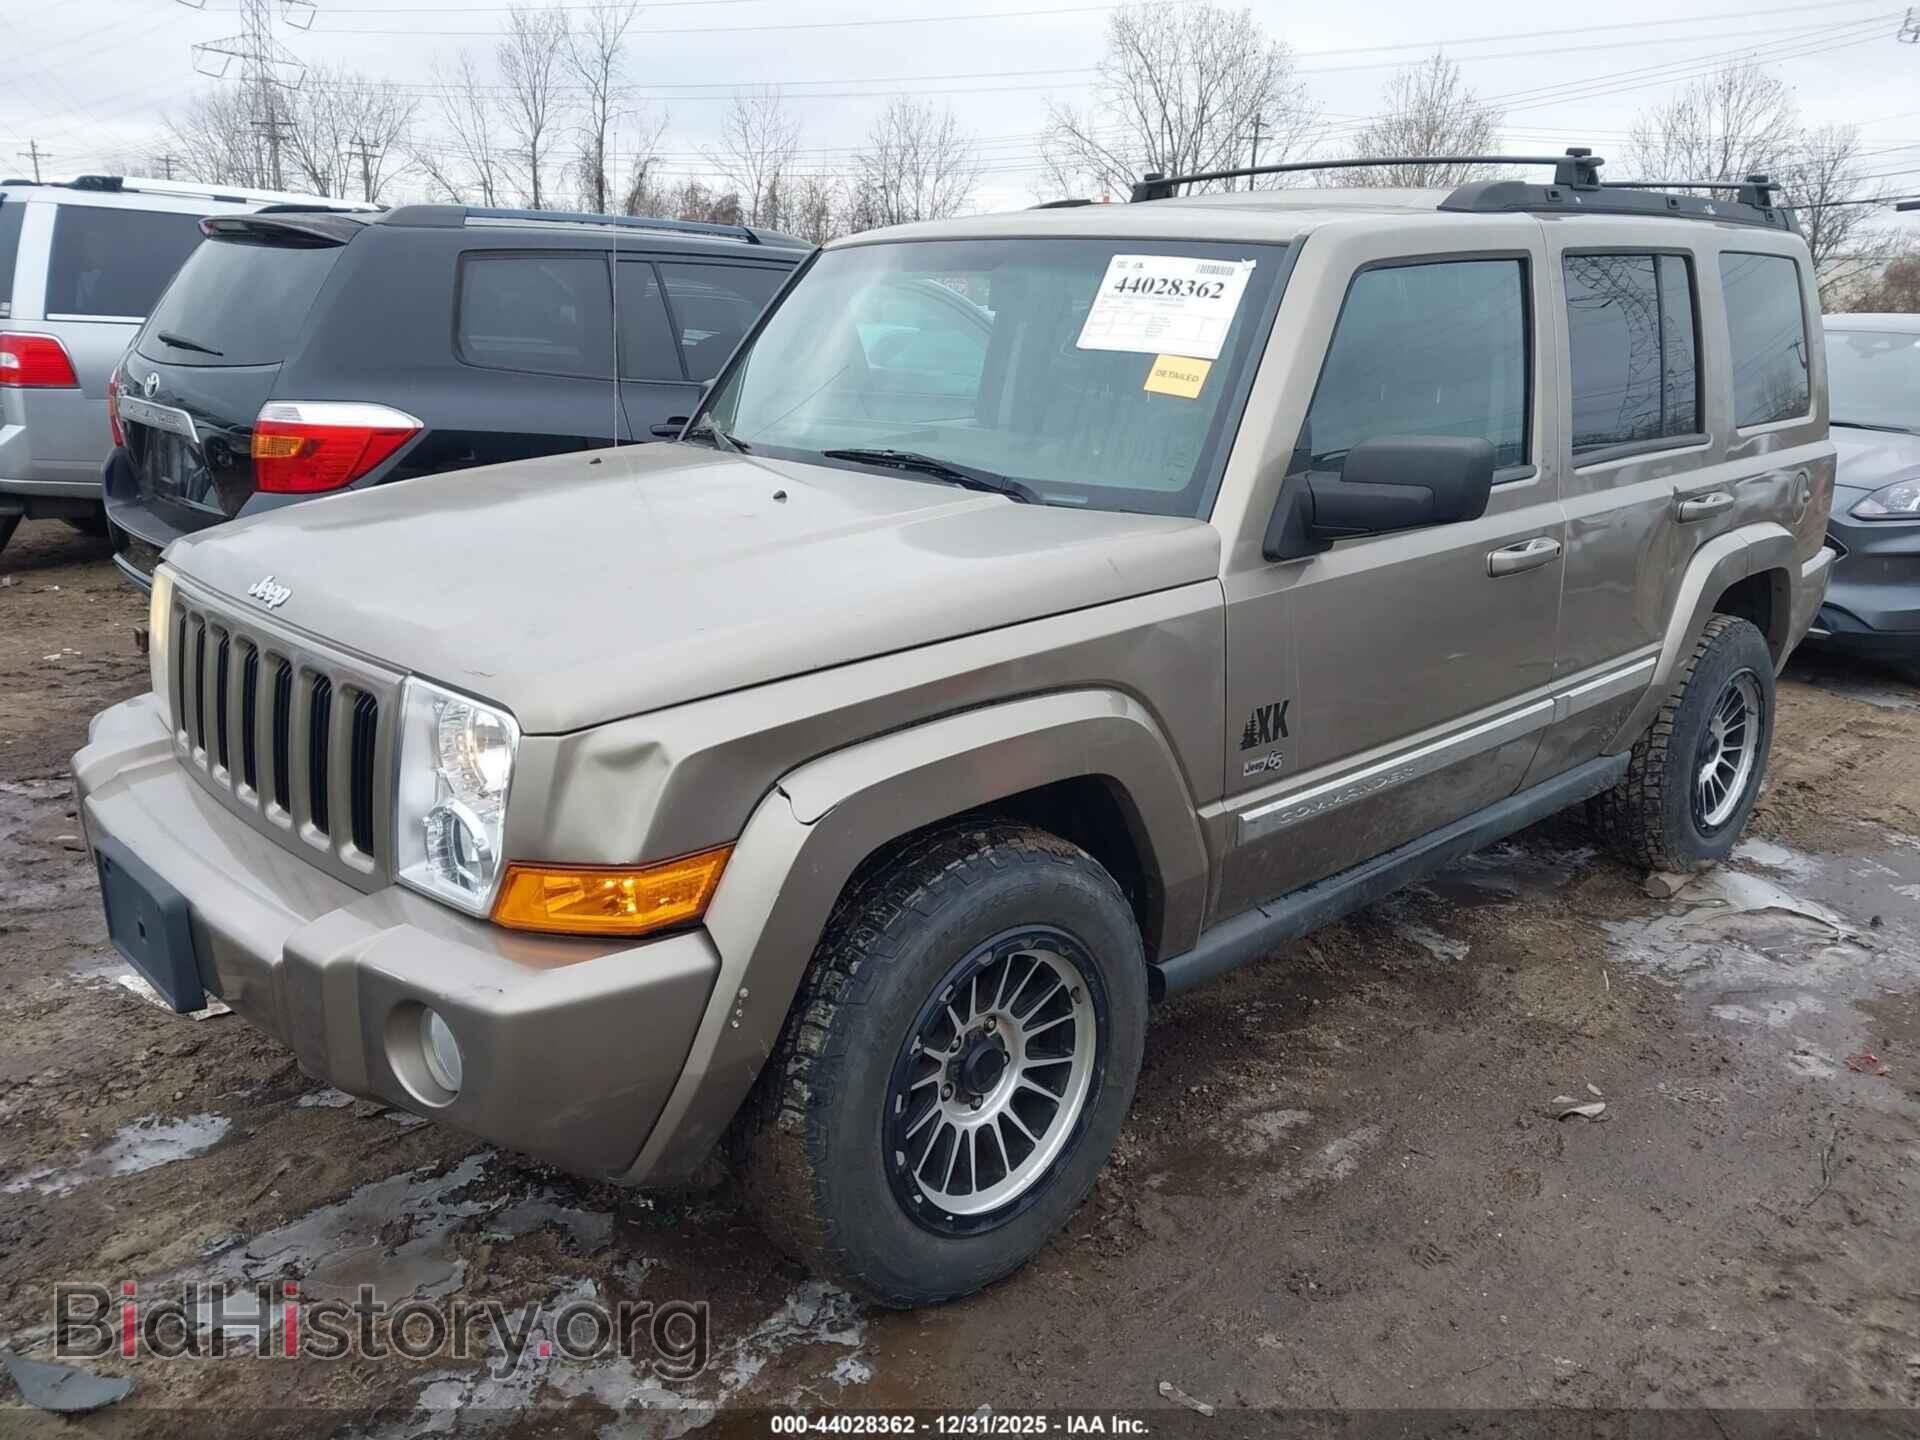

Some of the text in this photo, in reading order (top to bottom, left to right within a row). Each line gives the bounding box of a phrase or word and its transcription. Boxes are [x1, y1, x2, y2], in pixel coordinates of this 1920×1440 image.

[1114, 276, 1225, 300] 44028362
[1155, 369, 1200, 383] DETAILED
[247, 575, 292, 609] Jeep
[1256, 700, 1289, 744] XK
